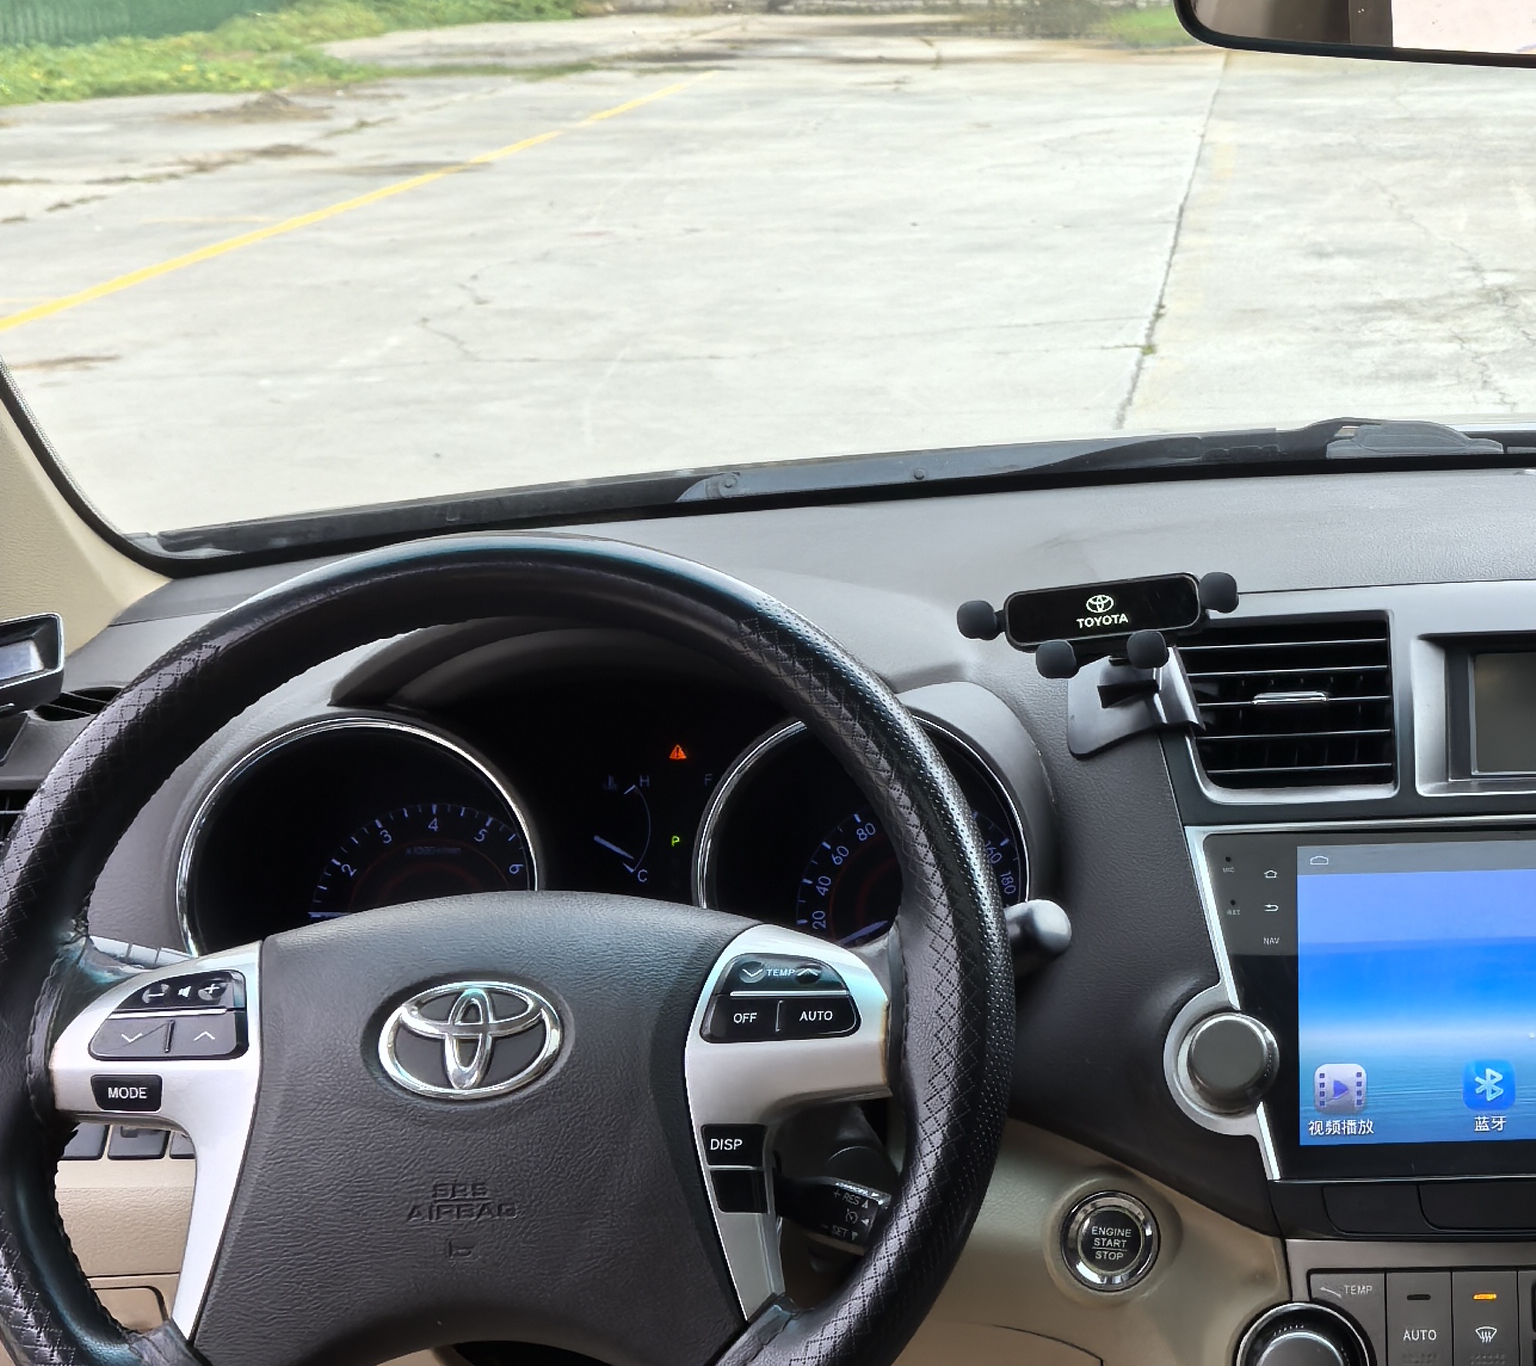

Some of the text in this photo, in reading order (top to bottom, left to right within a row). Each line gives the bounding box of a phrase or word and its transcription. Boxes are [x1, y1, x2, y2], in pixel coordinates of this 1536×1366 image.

[1076, 613, 1129, 629] TOYOTA
[427, 817, 439, 832] 4
[855, 821, 877, 842] 80
[379, 829, 392, 845] 3
[474, 828, 488, 843] 5
[830, 844, 850, 867] 60
[340, 862, 358, 877] 2
[508, 863, 524, 875] 6
[637, 868, 649, 883] C
[815, 875, 832, 897] 40
[1000, 870, 1017, 895] 180
[812, 910, 827, 930] 20
[1263, 937, 1280, 946] NAV
[767, 968, 795, 977] TEMP
[733, 1012, 758, 1024] OFF
[799, 1010, 834, 1022] AUTO
[107, 1087, 148, 1099] MODE
[1308, 1119, 1375, 1136] 视频播放
[1474, 1115, 1507, 1133] 蓝牙
[709, 1138, 743, 1151] DISP
[842, 1192, 861, 1206] RES
[1091, 1226, 1132, 1238] ENGINE
[1093, 1237, 1127, 1248] START
[1095, 1251, 1123, 1260] STOP
[1343, 1284, 1373, 1295] TEMP
[1402, 1329, 1437, 1341] AUTO
